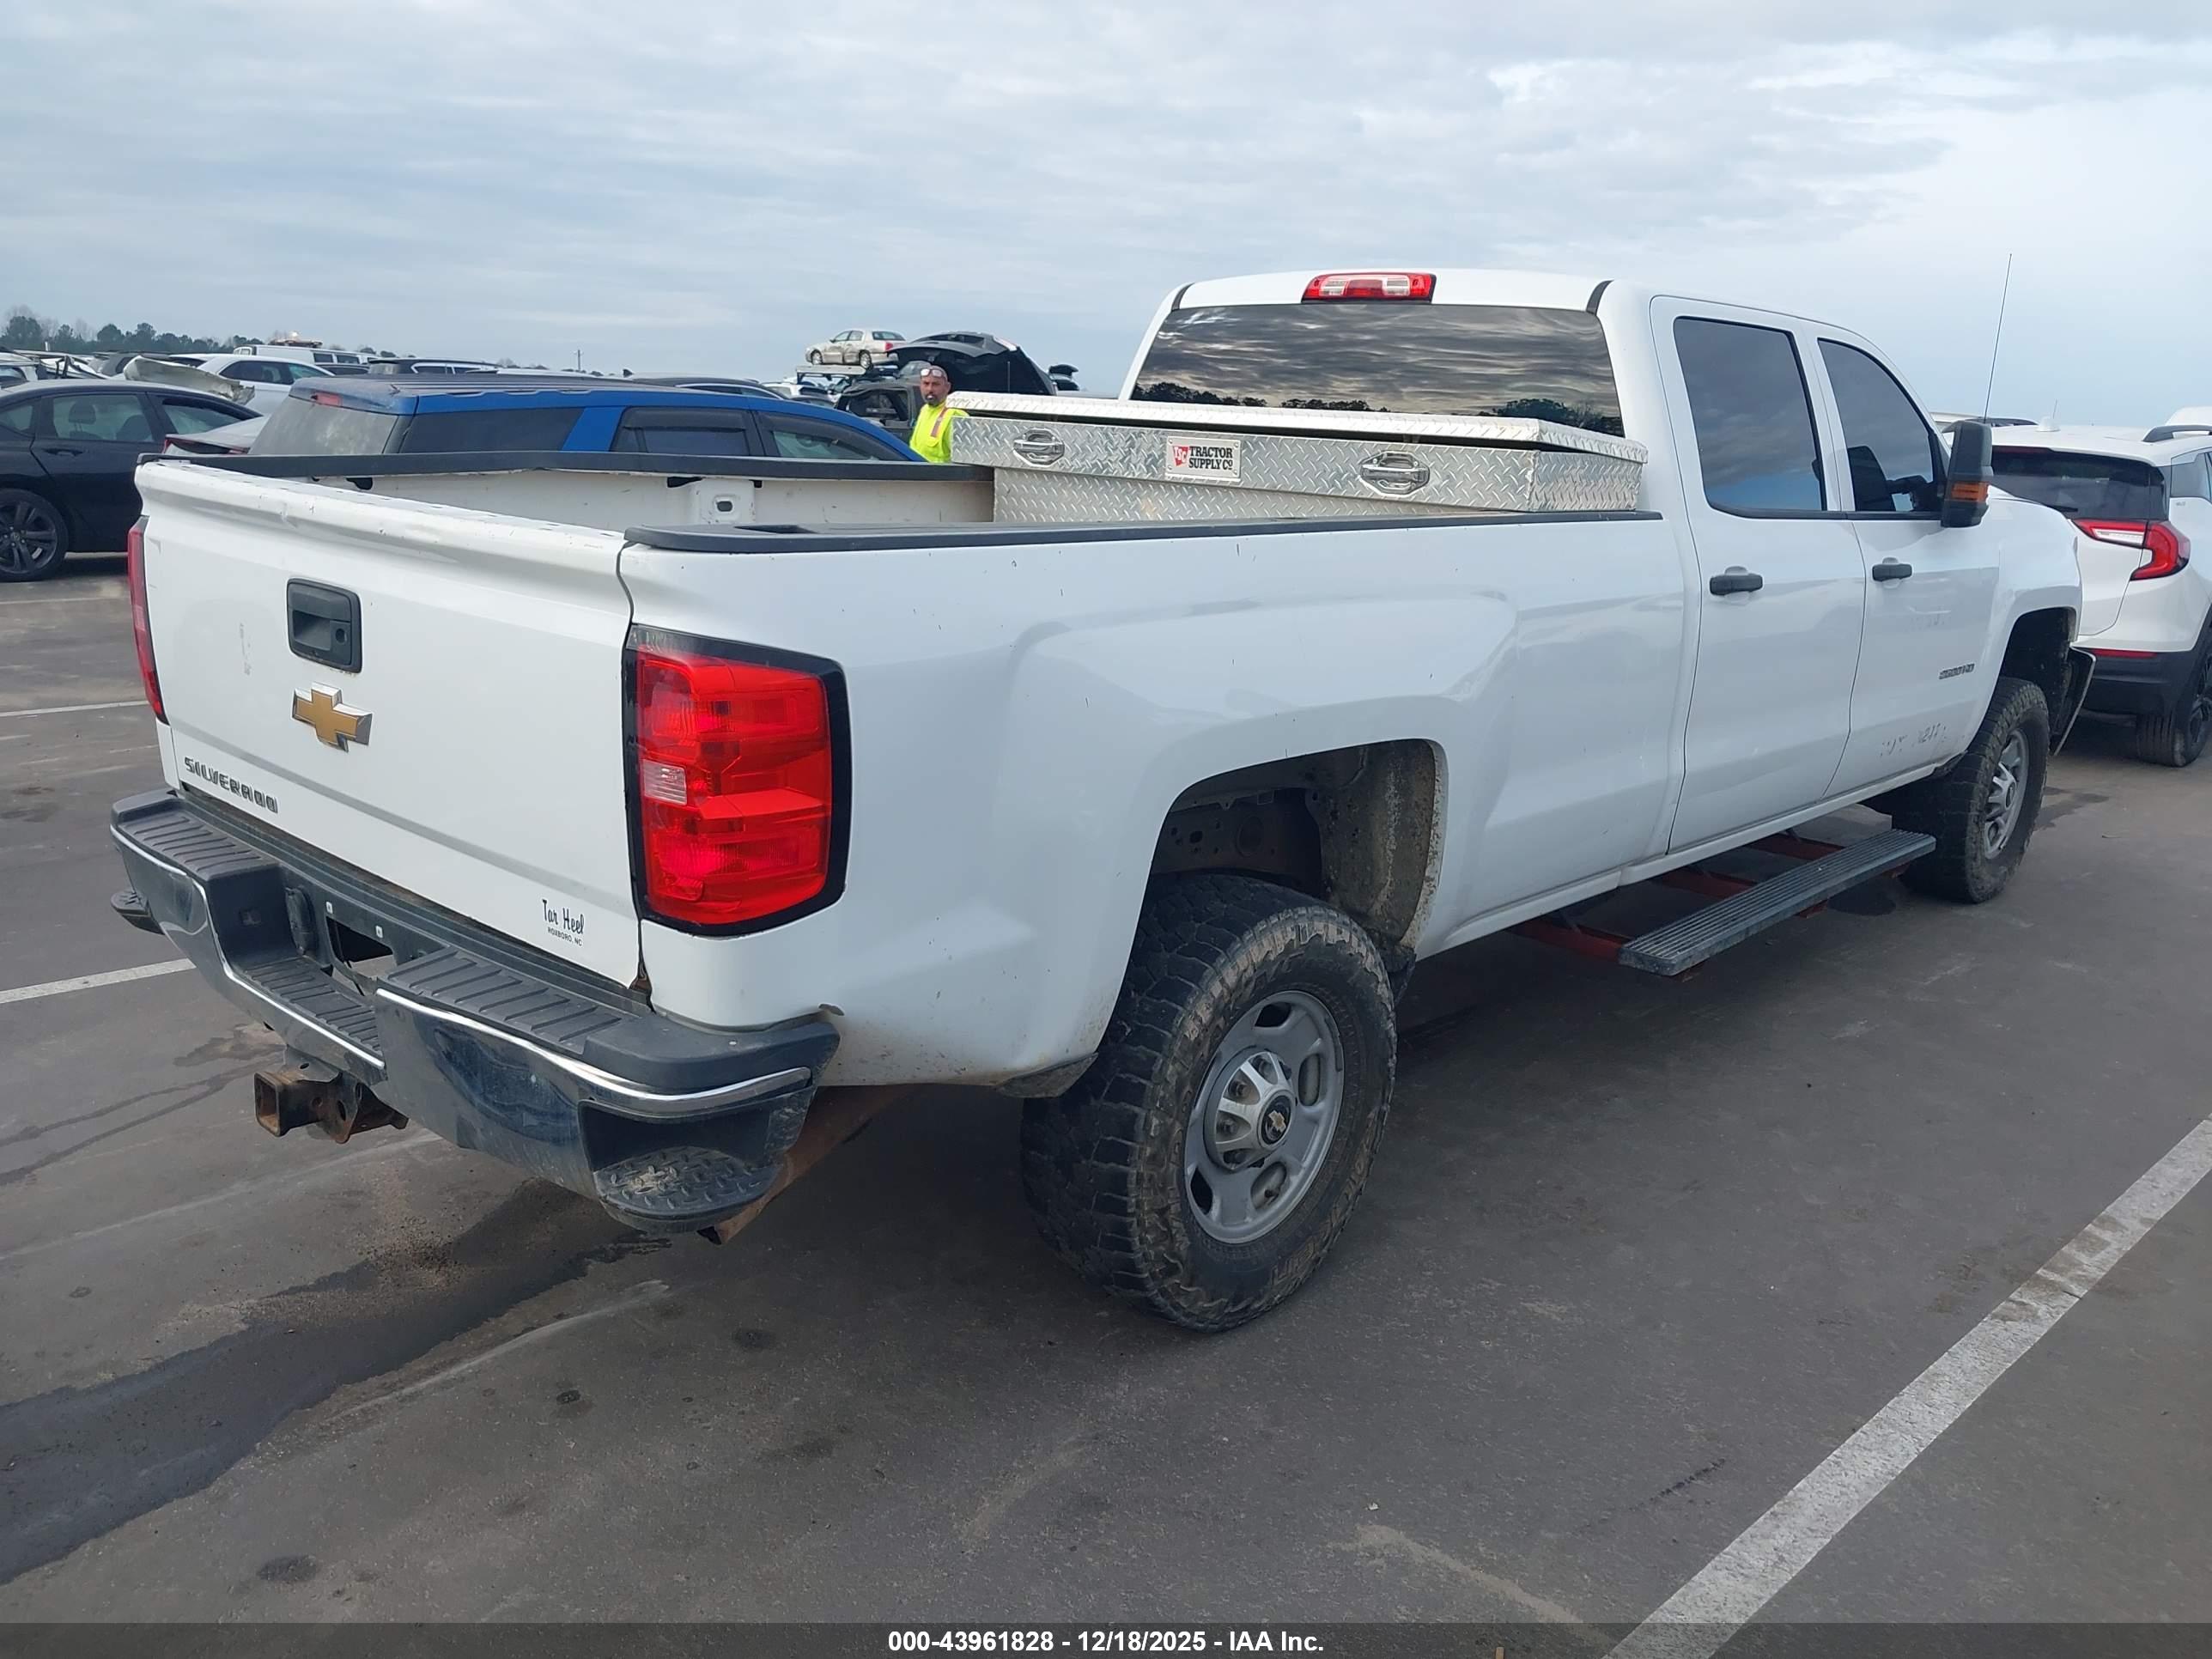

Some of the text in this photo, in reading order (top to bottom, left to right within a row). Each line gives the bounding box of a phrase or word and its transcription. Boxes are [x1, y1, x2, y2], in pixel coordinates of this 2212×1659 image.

[1189, 446, 1233, 459] TRACTOR
[1188, 458, 1222, 470] SUPPLY
[184, 756, 279, 814] SILVERADO
[542, 898, 585, 934] Tar Heel
[574, 937, 583, 946] NC
